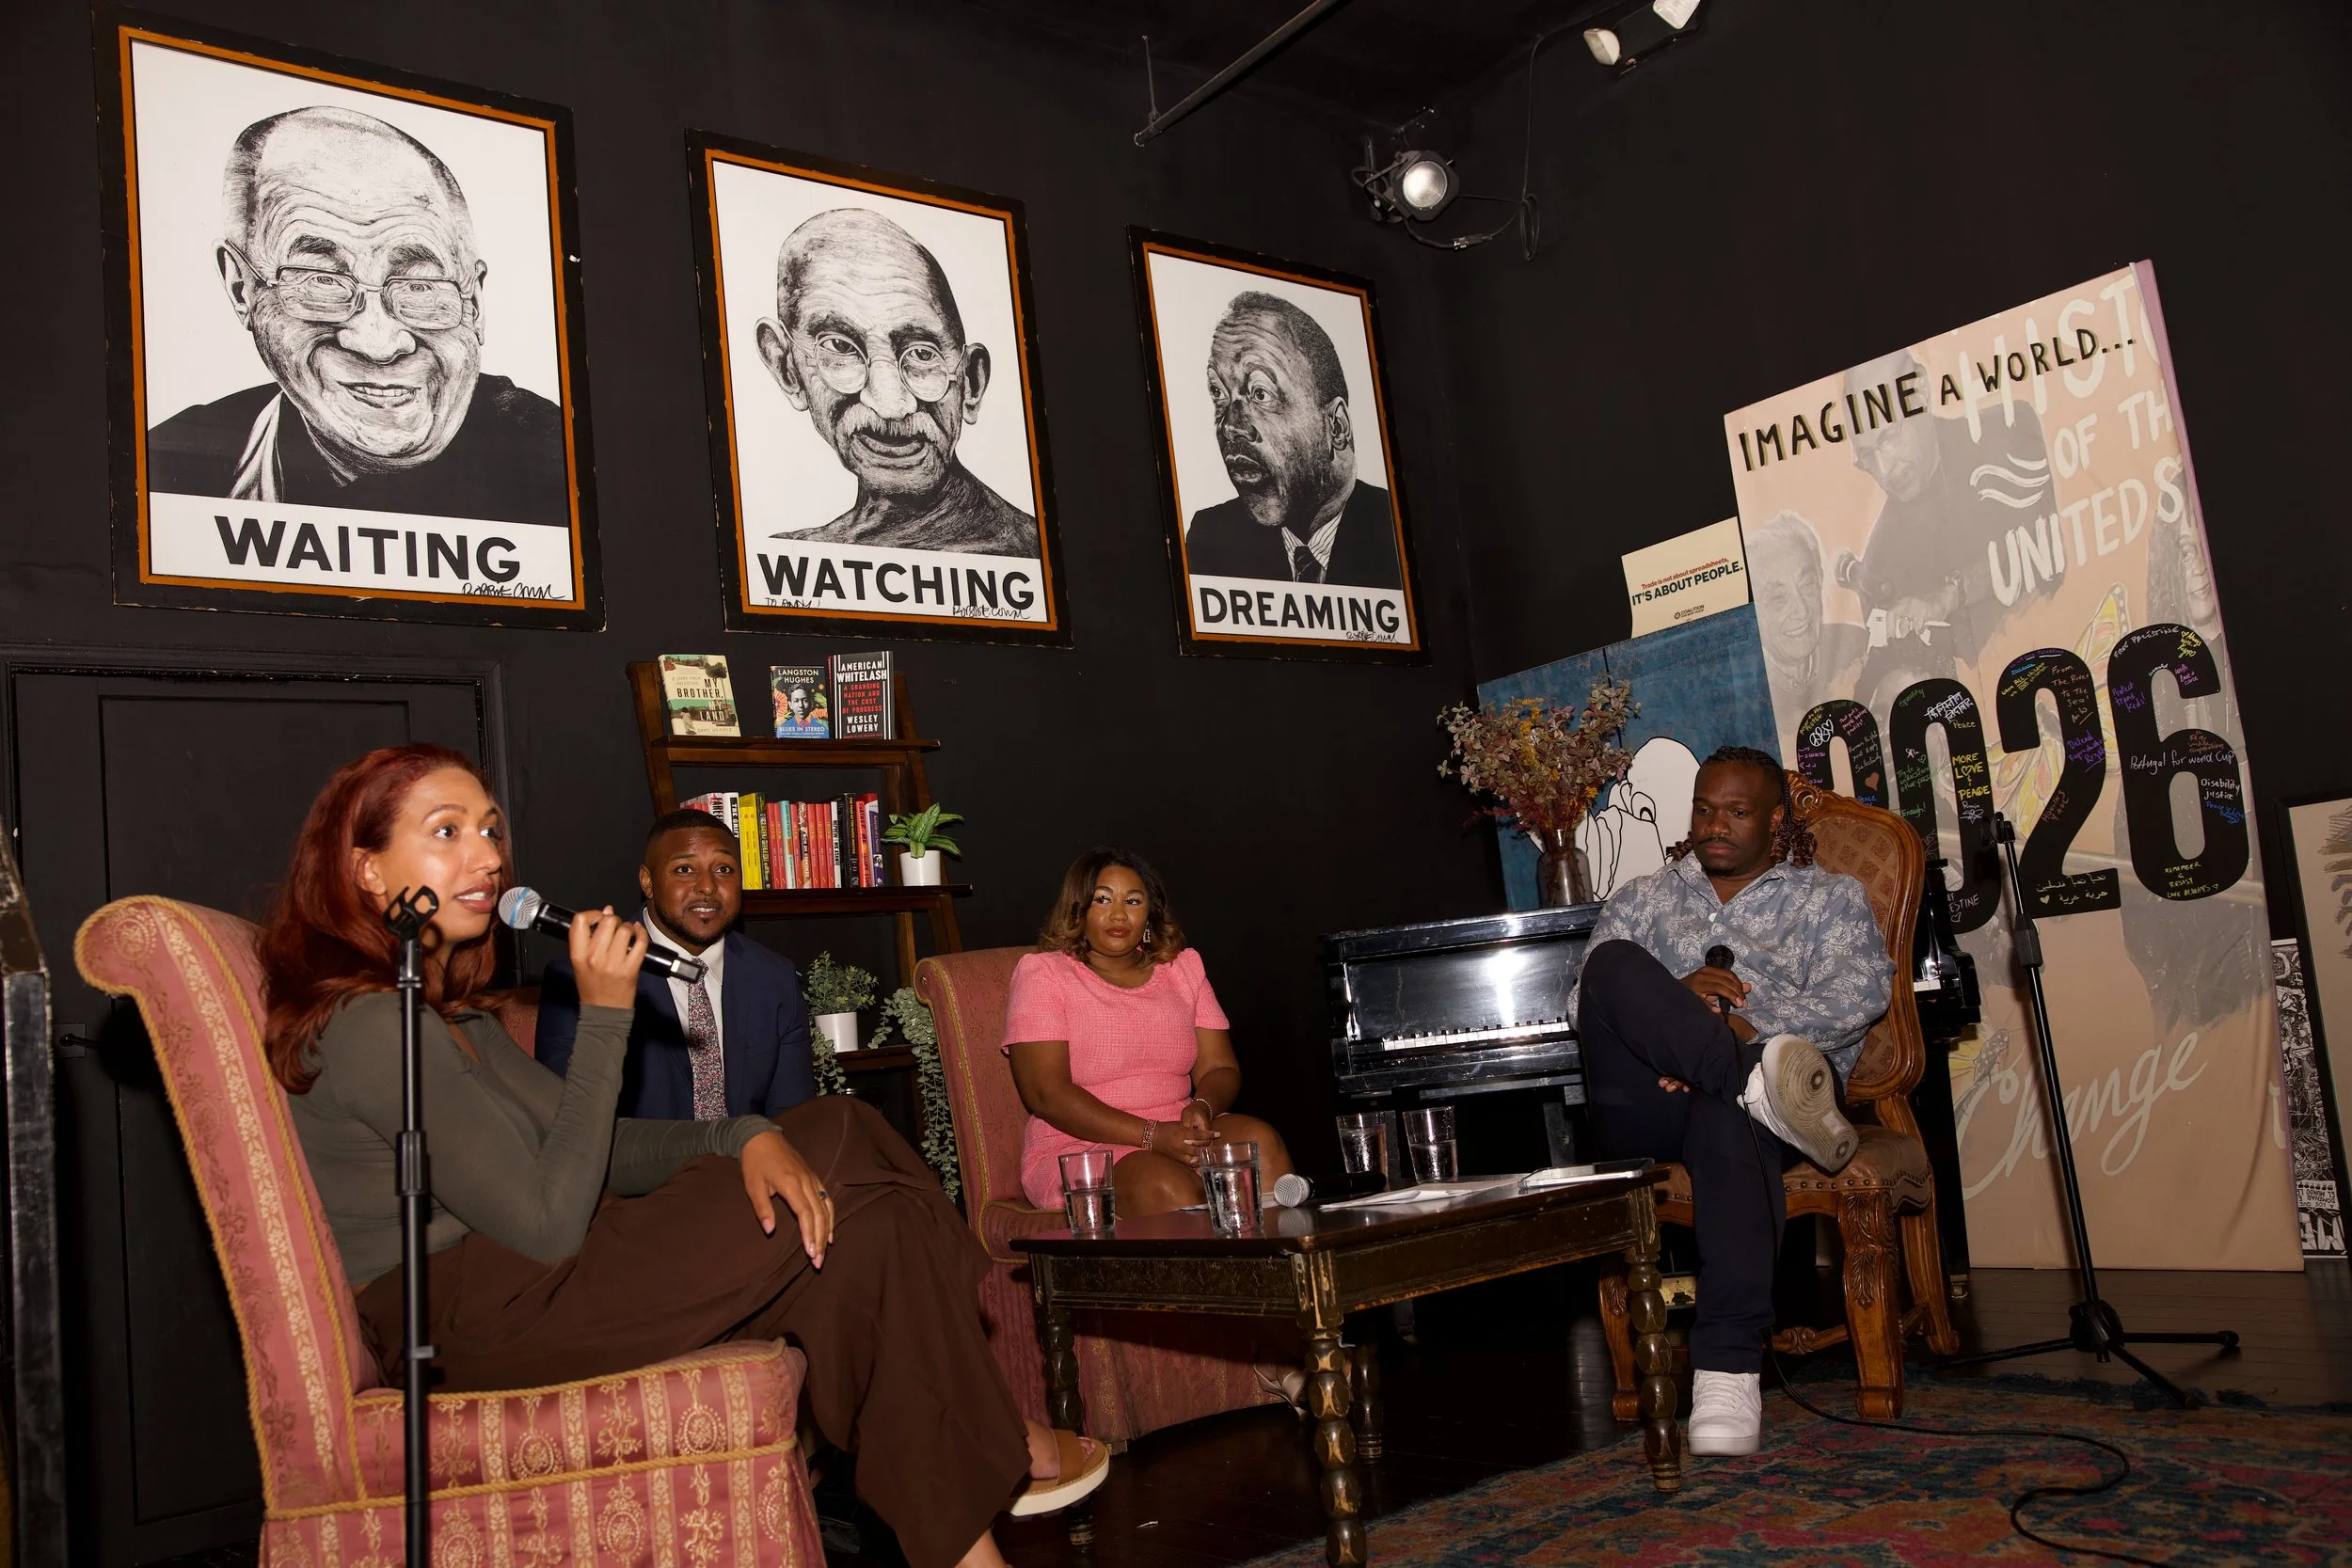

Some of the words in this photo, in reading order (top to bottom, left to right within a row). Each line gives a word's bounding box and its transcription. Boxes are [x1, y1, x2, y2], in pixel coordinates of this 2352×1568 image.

[1739, 372, 1925, 472] IMAGINE
[1940, 373, 1963, 406] A
[1977, 327, 2137, 393] WORLD...
[2053, 413, 2100, 480] OF
[214, 515, 521, 582] WAITING
[1988, 478, 2149, 608] UNITED
[756, 553, 1035, 610] WATCHING
[1632, 591, 1653, 606] IT'S
[1654, 577, 1692, 599] ABOUT
[1695, 561, 1743, 585] PEOPLE.
[1642, 581, 1657, 590] Trade
[1673, 570, 1689, 579] about
[1200, 587, 1400, 633] DREAMING
[1680, 605, 1705, 615] COALITION
[841, 661, 882, 672] AMERICAN
[704, 678, 718, 688] MY
[836, 670, 887, 683] WHITELASH
[708, 700, 723, 711] MY
[699, 711, 724, 721] LAND
[847, 714, 879, 724] WESLEY
[847, 723, 879, 734] LOWERY
[1951, 752, 1979, 767] MORE
[2130, 752, 2166, 775] Portugal
[2170, 749, 2187, 767] for
[2201, 778, 2240, 796] Disability
[2168, 877, 2193, 888] RESIST
[1948, 894, 1979, 912] ESTINE
